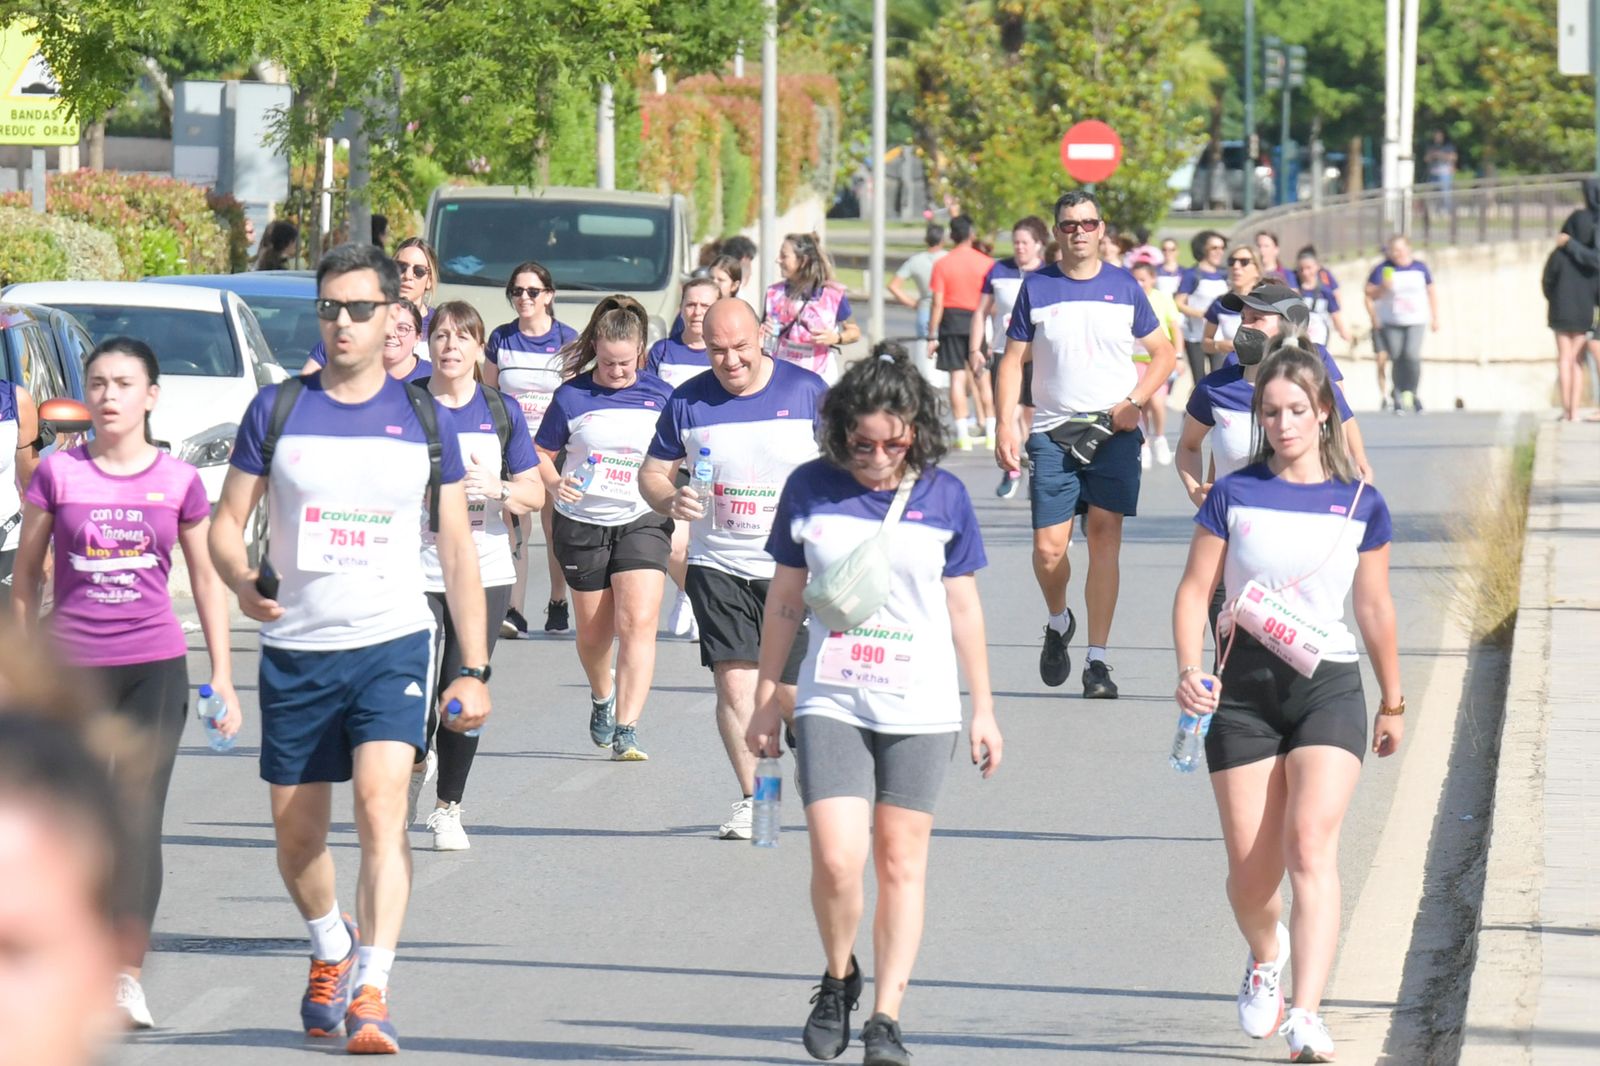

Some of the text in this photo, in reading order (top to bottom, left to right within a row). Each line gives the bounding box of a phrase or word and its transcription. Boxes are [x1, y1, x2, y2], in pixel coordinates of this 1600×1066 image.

[11, 109, 58, 120] BANDAS
[43, 125, 76, 136] ORAS
[520, 402, 538, 411] 122
[602, 457, 641, 469] COVIRA
[605, 468, 632, 483] 7449
[730, 500, 757, 515] 7779
[736, 521, 761, 530] vithas
[330, 528, 366, 546] 7514
[1263, 617, 1297, 646] 993
[851, 643, 885, 664] 990
[855, 673, 889, 684] vithas
